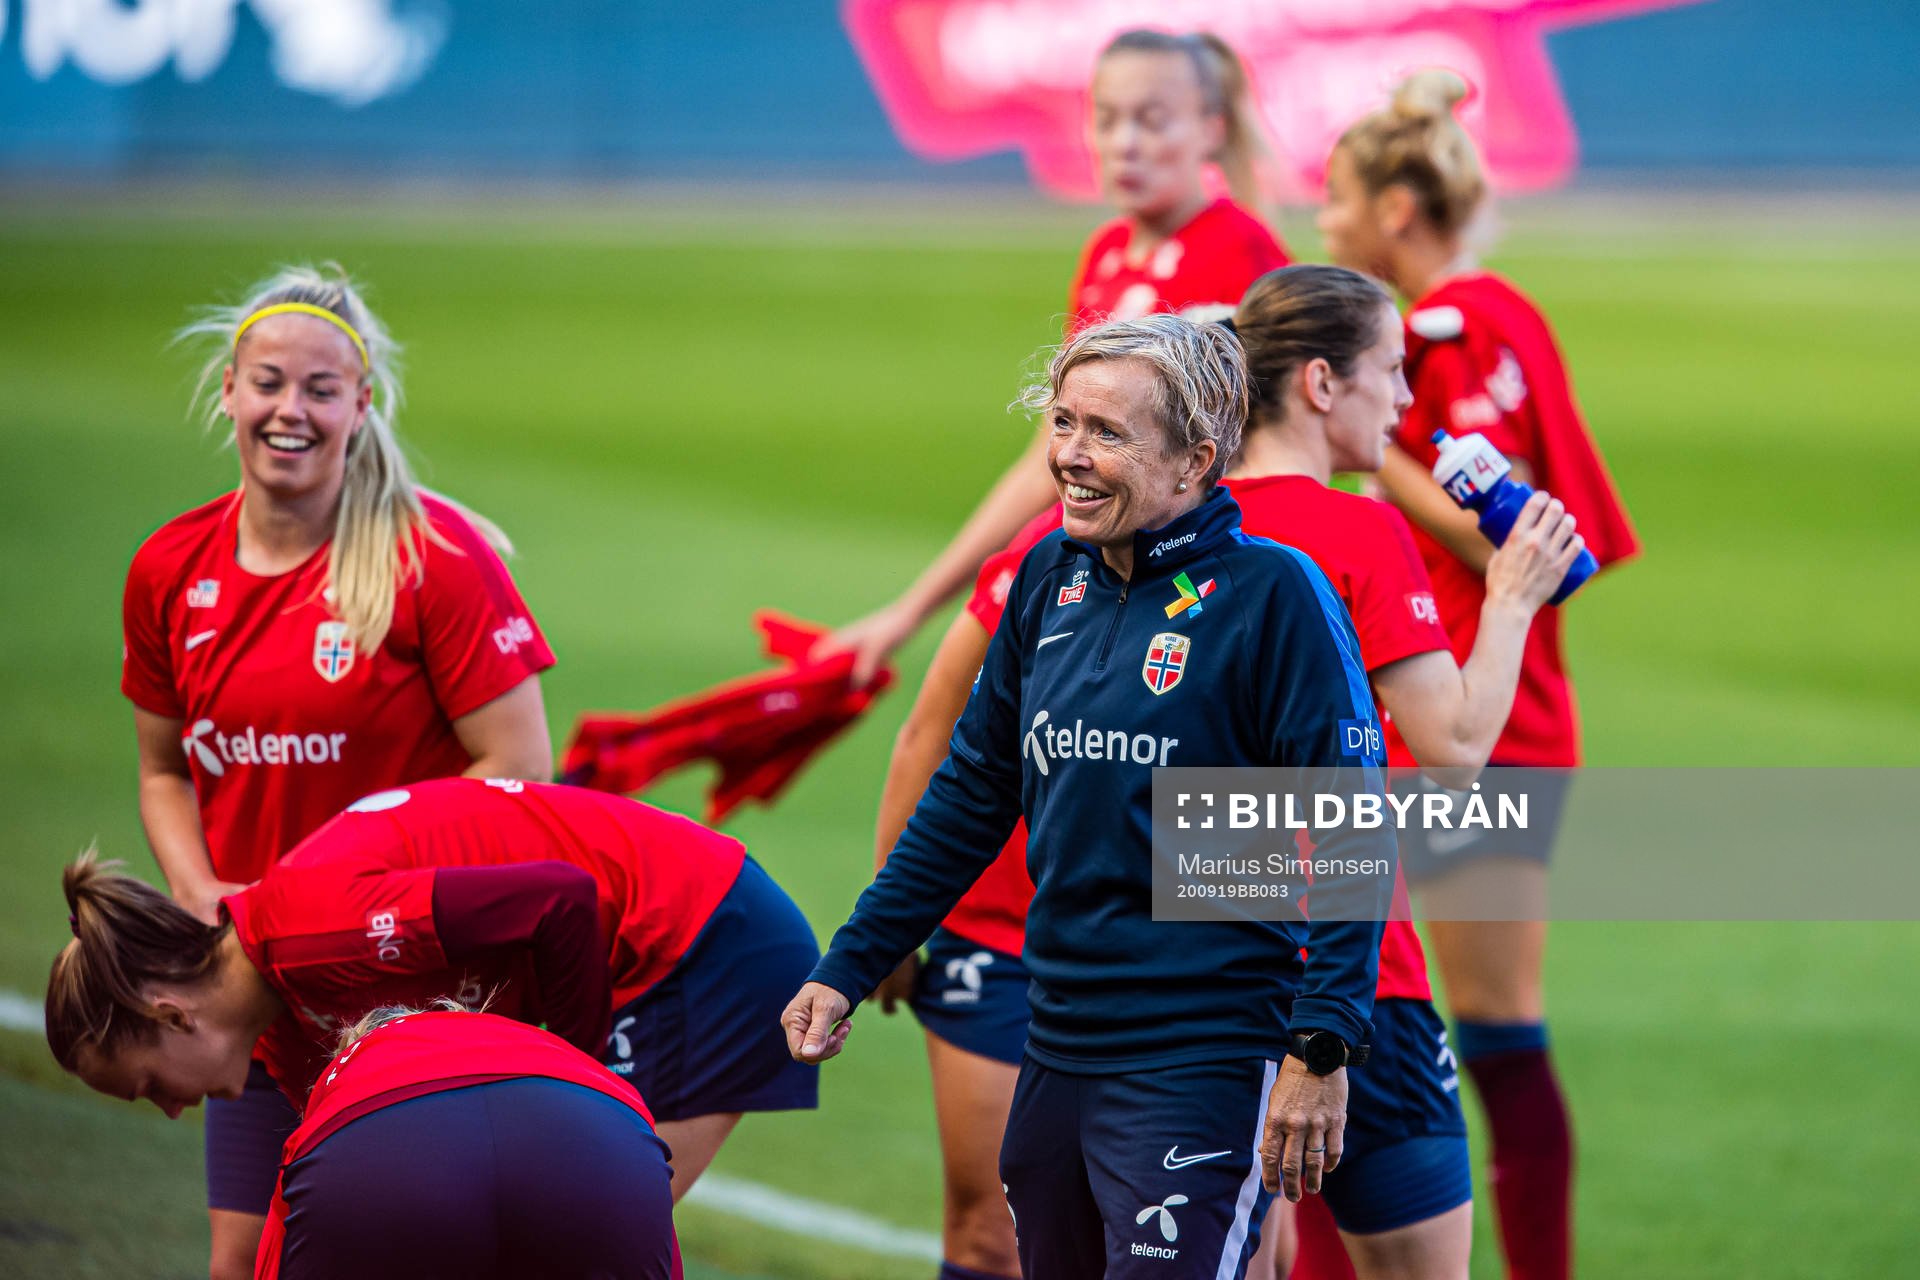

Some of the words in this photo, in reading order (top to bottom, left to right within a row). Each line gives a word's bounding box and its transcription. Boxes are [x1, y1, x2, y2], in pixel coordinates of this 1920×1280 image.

[1161, 532, 1197, 551] telenor
[215, 726, 347, 765] telenor
[1045, 719, 1179, 767] telenor
[1347, 719, 1380, 756] DNB
[1130, 1242, 1179, 1260] telenor
